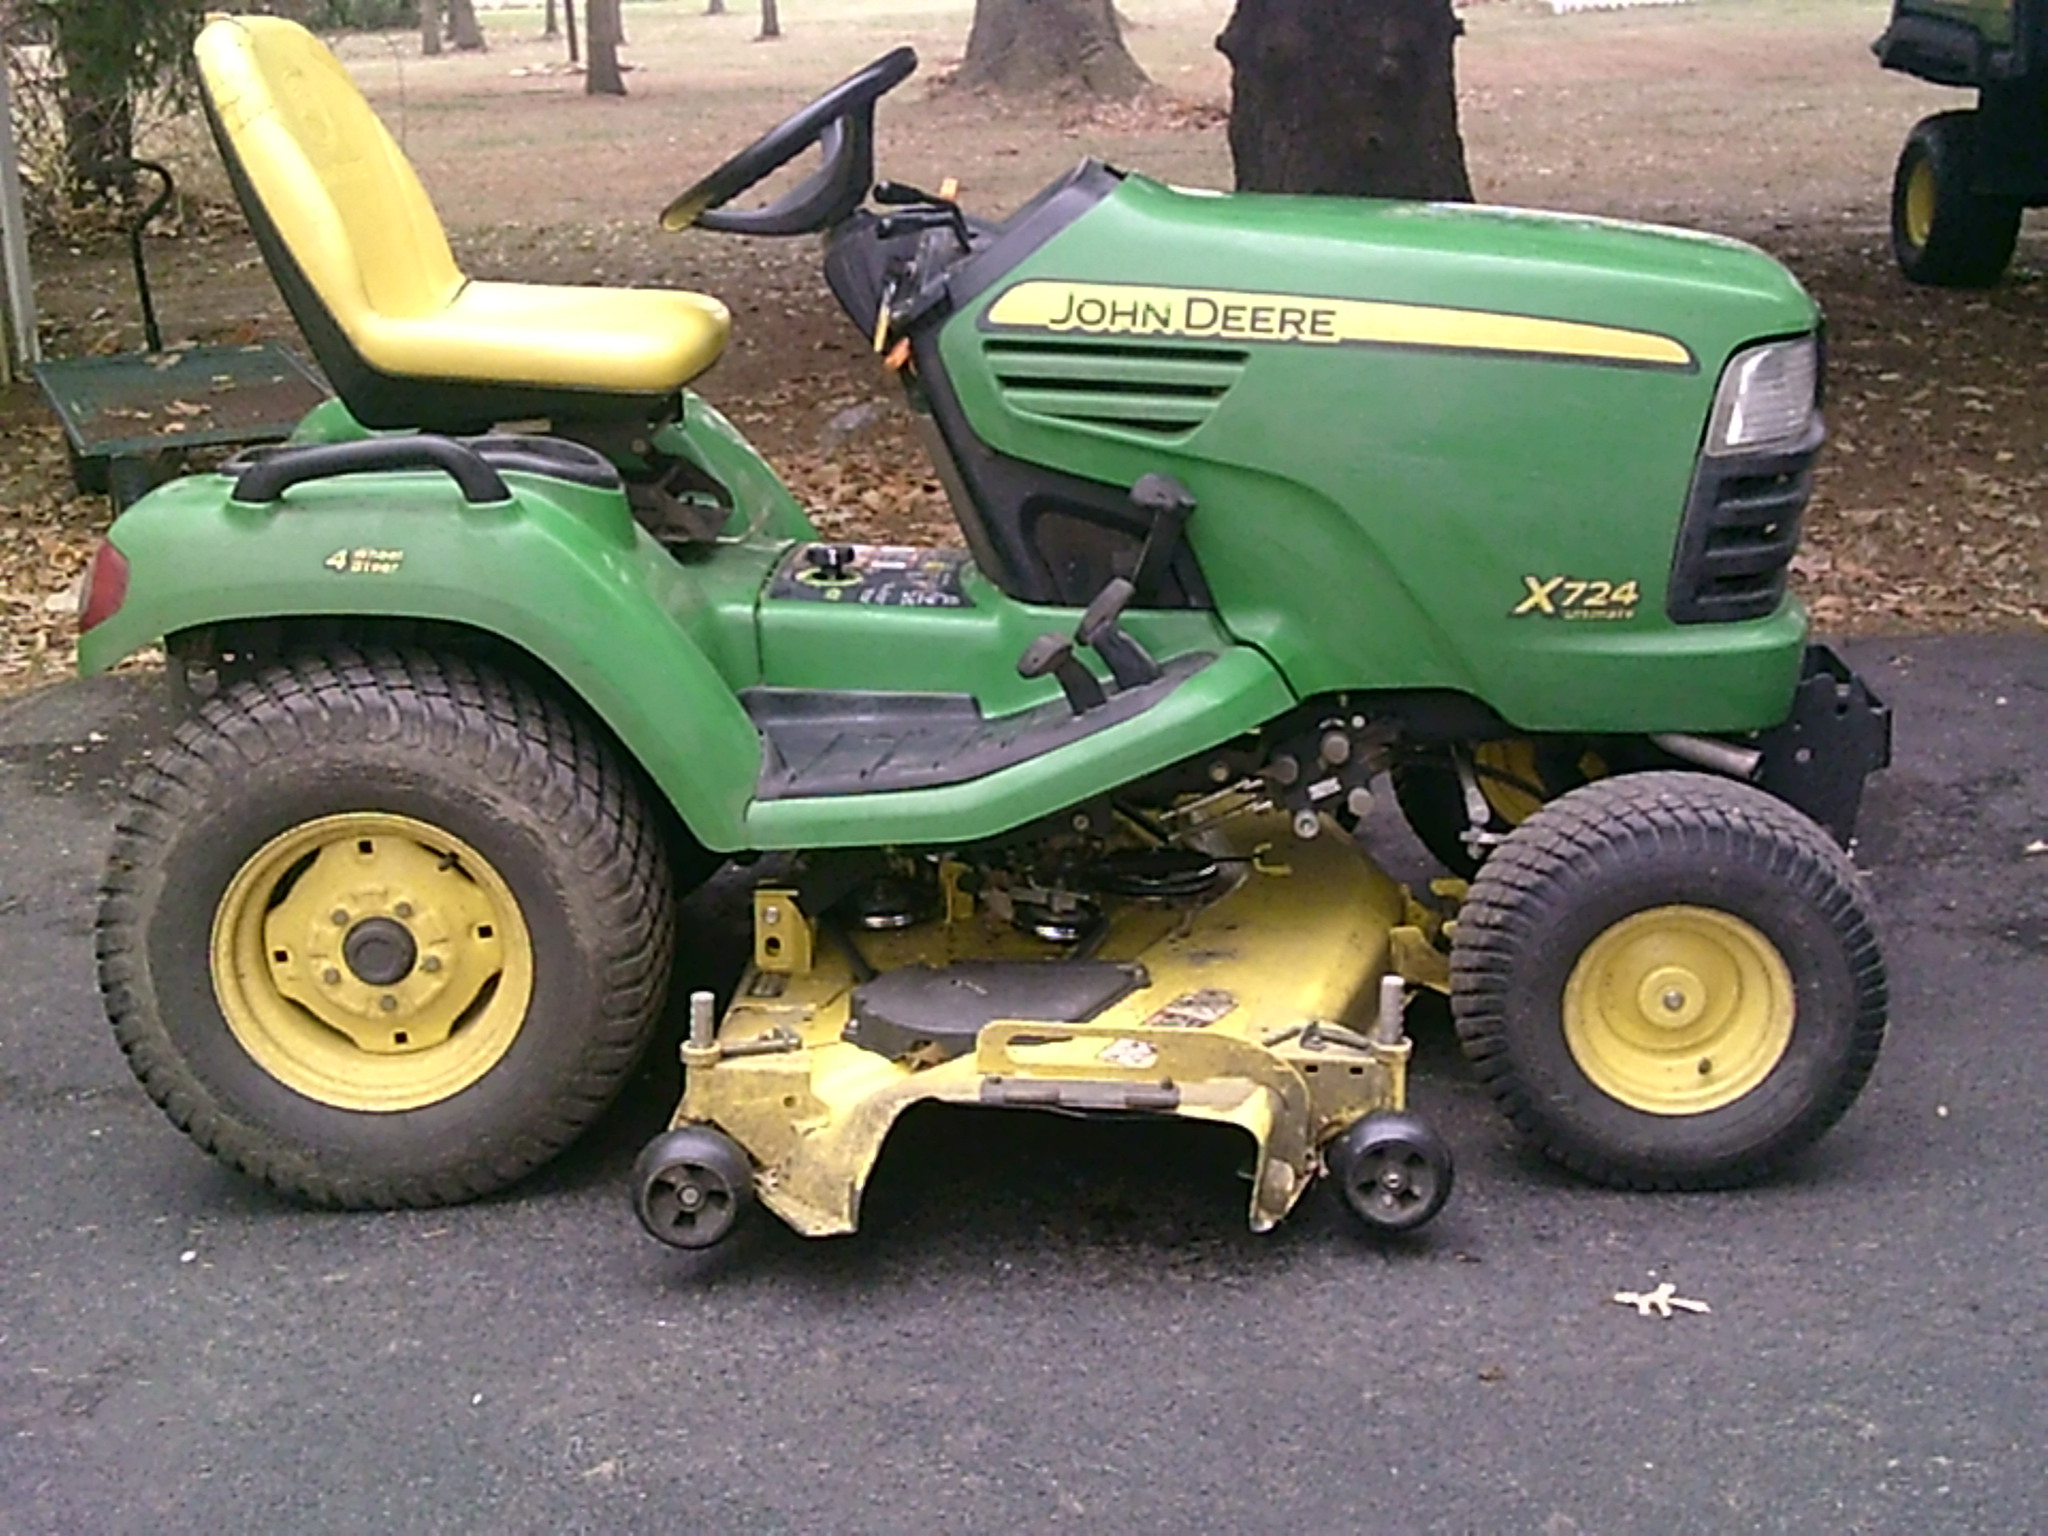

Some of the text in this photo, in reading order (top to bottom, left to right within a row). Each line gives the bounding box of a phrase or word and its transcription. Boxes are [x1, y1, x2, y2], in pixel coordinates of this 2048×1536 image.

[1050, 292, 1336, 336] JOHN DEERE
[325, 549, 347, 570] 4
[1513, 576, 1638, 614] X724
